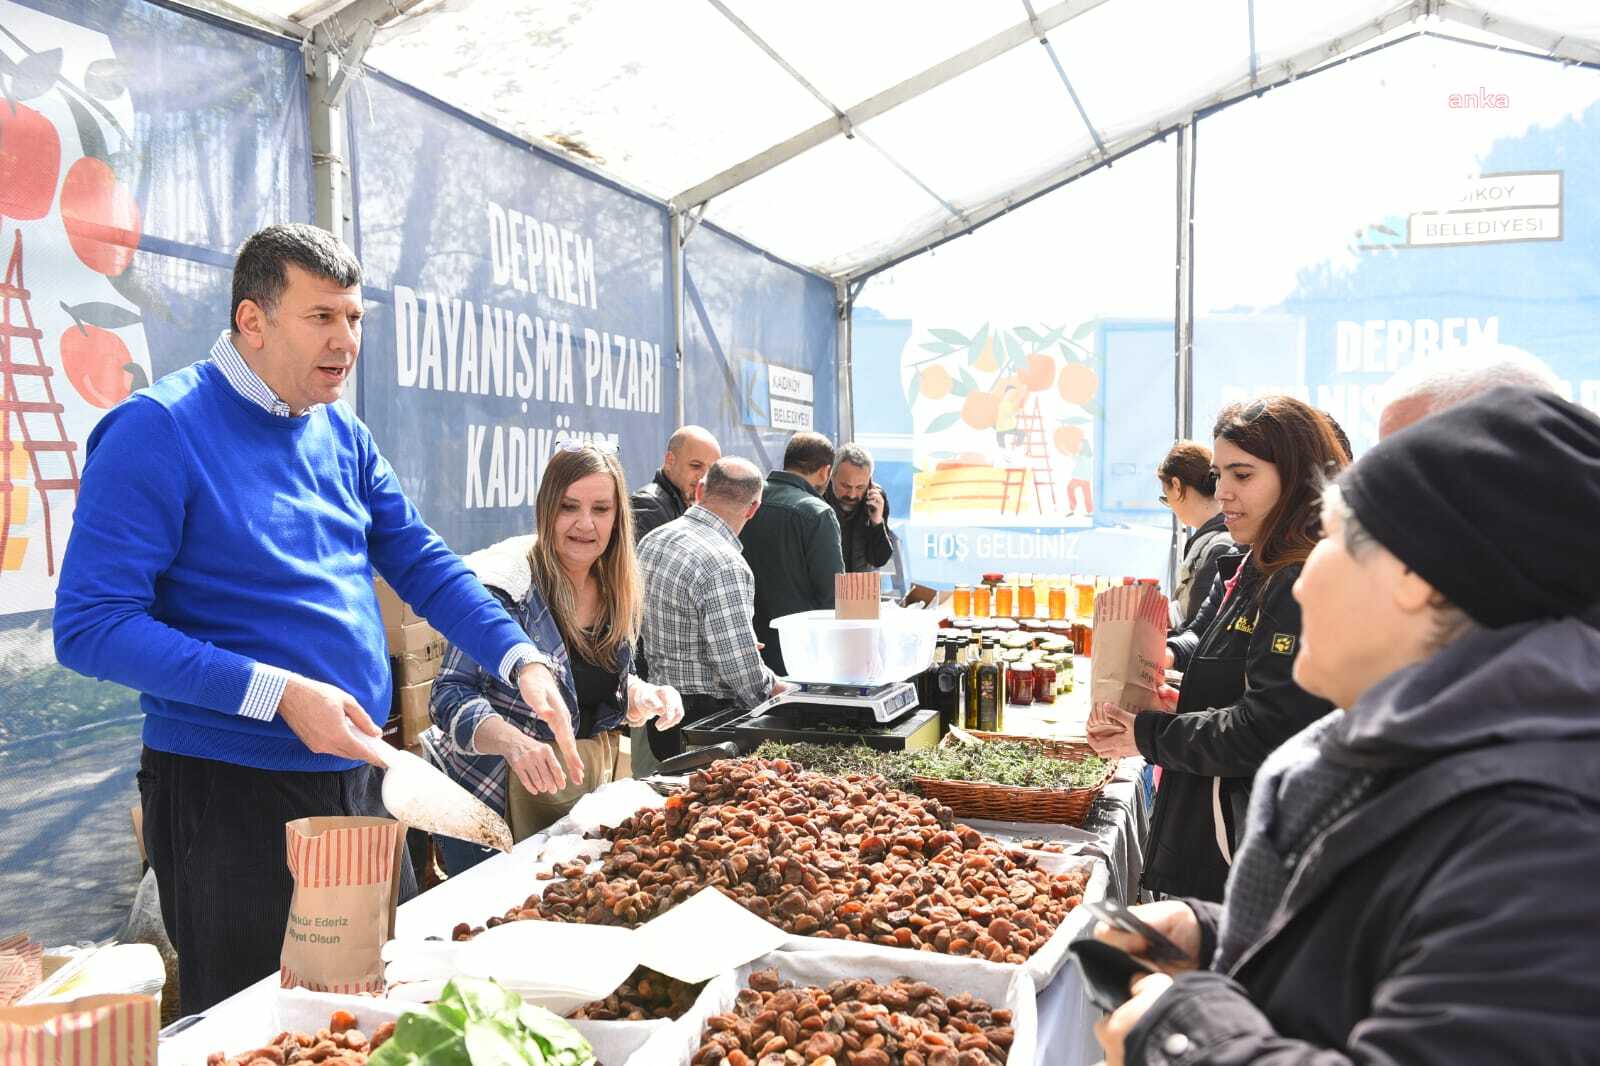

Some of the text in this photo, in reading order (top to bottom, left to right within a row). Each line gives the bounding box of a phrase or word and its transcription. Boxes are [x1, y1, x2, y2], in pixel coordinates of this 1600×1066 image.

[487, 201, 597, 310] DEPREM
[393, 285, 662, 414] DAYANIŞMA PAZARI
[1336, 316, 1499, 372] DEPREM
[925, 528, 1080, 562] HOŞ GELDİNİZ
[309, 932, 341, 945] Olsun
[314, 915, 349, 928] Ederiz
